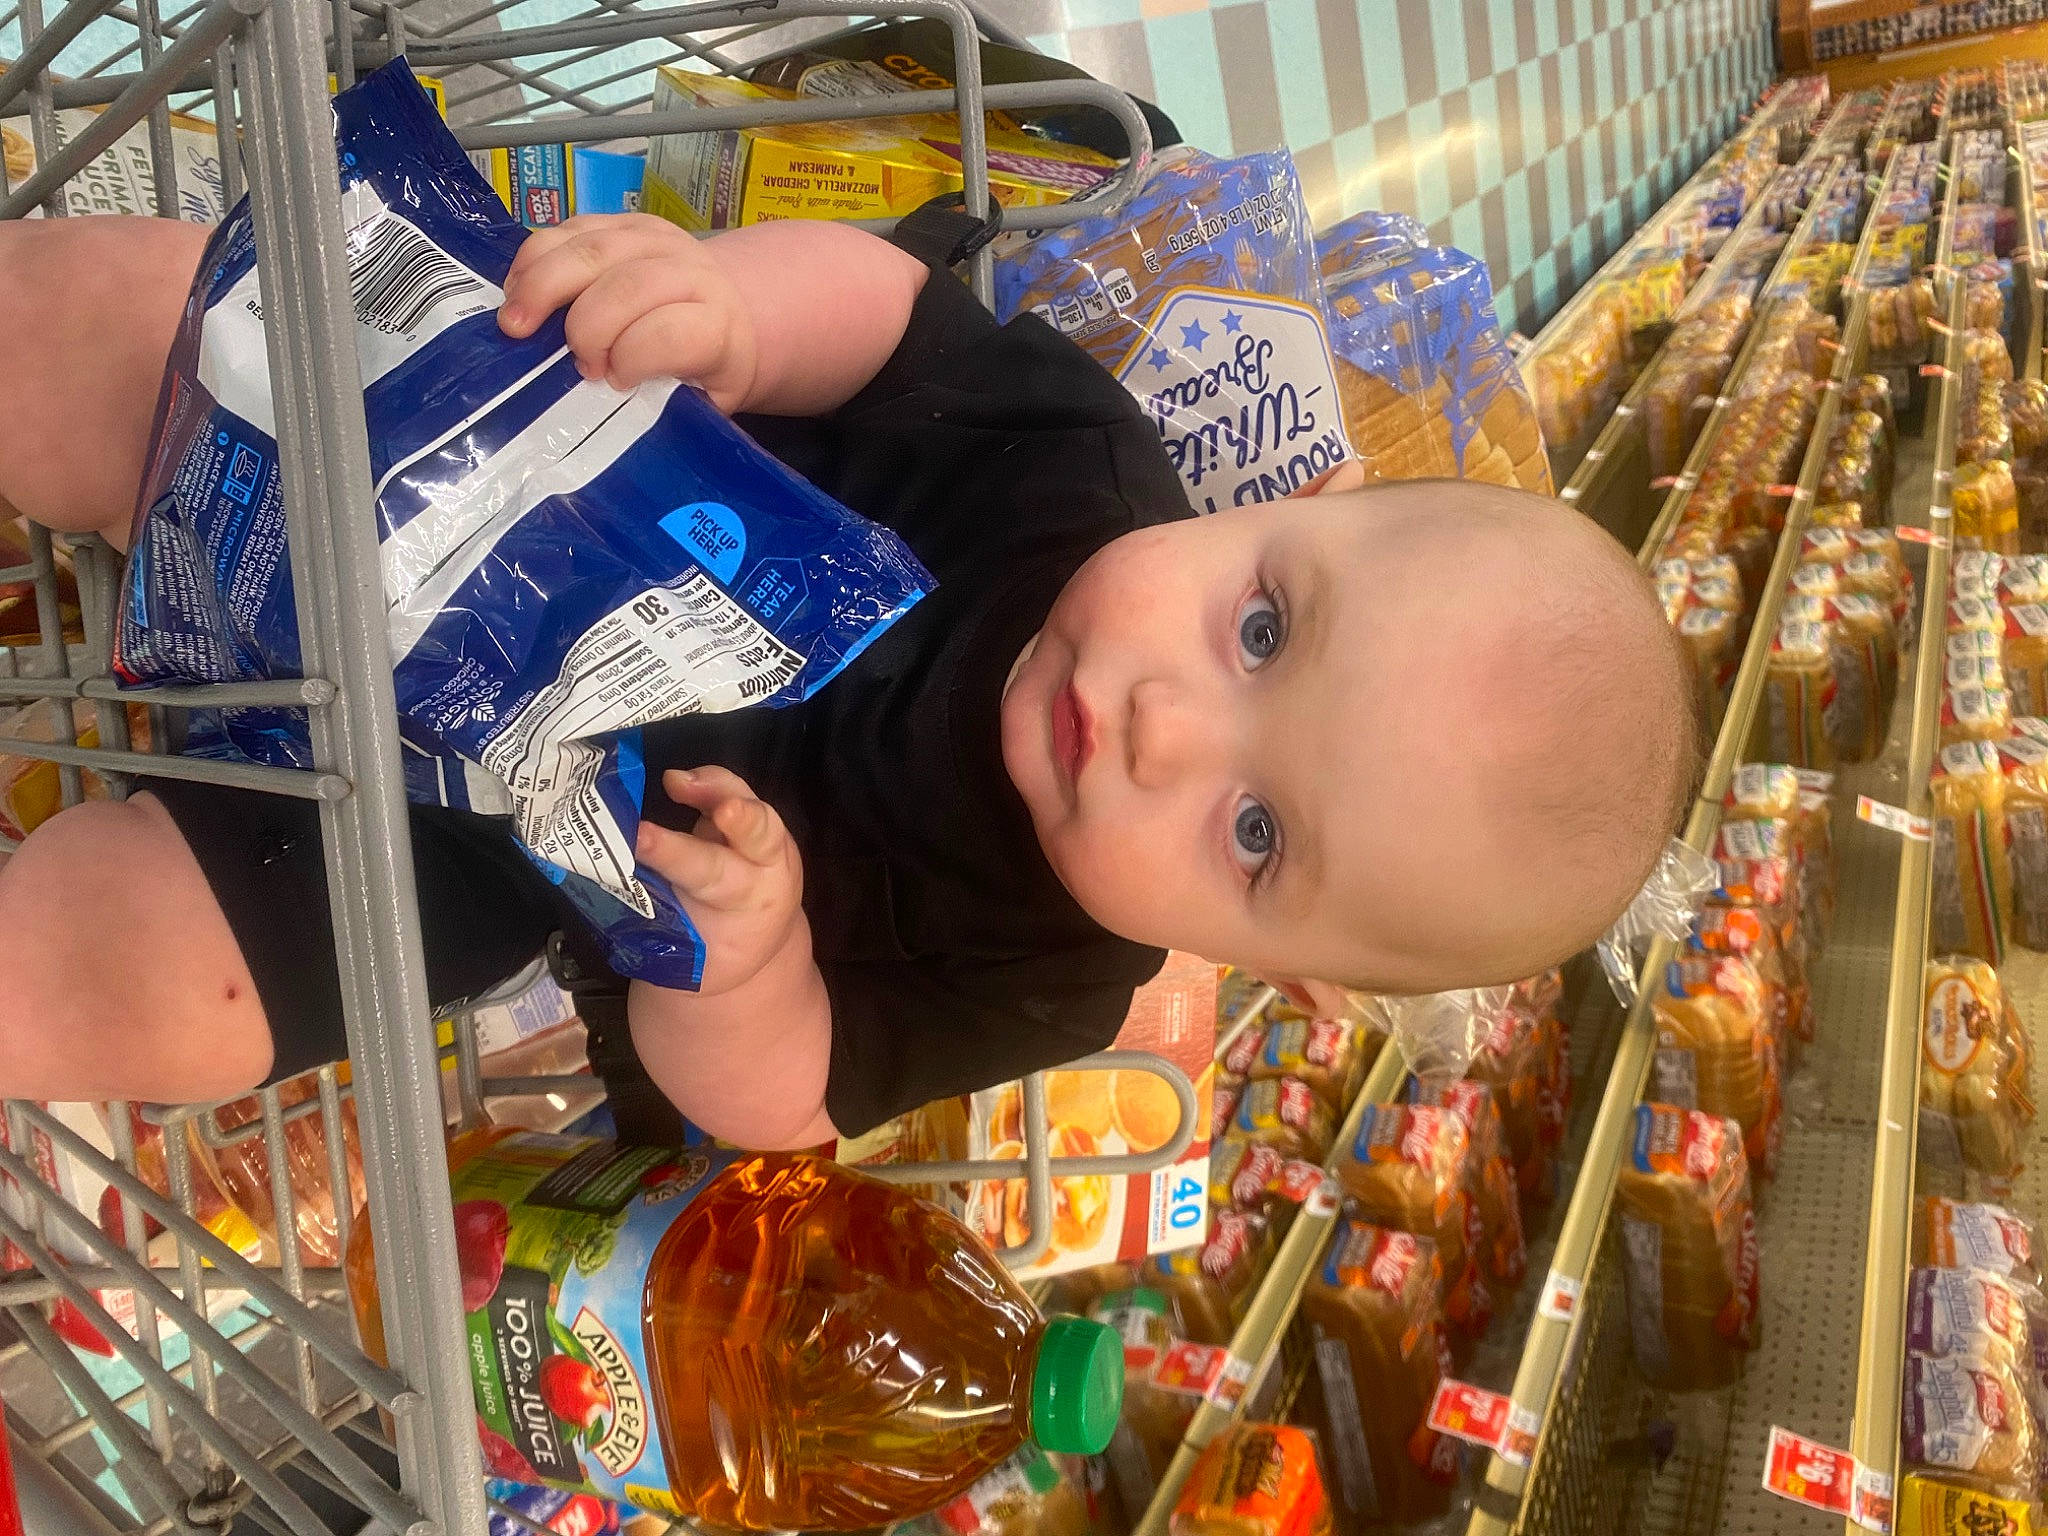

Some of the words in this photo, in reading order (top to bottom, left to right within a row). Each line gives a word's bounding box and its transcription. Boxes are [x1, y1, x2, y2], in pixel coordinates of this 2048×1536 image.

[884, 55, 954, 89] cro
[510, 162, 519, 174] THE
[789, 161, 843, 175] PARMESAN
[849, 166, 855, 177] &
[84, 165, 112, 210] UCE
[102, 149, 133, 214] PRIMA
[760, 174, 810, 190] CHEDDAR,
[816, 178, 879, 195] MOZZARELLA,
[180, 190, 210, 224] Me
[530, 194, 546, 224] BOX
[541, 189, 553, 220] TOPS
[778, 193, 803, 207] Real
[806, 197, 829, 208] with
[831, 199, 863, 211] Made
[1256, 193, 1272, 208] OZ
[1220, 215, 1228, 230] 4
[1227, 206, 1244, 225] LB
[1253, 216, 1273, 234] WT
[1168, 228, 1200, 252] 567g
[1114, 284, 1132, 304] 80
[246, 301, 264, 321] BES
[1150, 334, 1273, 437] Bread
[204, 422, 214, 445] SIDE
[1162, 383, 1316, 486] White
[211, 451, 225, 482] PLACE
[269, 462, 279, 480] ANY
[1233, 428, 1345, 508] ROUND
[253, 481, 274, 532] LEFTOVERS.
[262, 510, 275, 535] COOK
[691, 508, 720, 538] PICK
[718, 532, 739, 551] UP
[240, 533, 257, 568] REHEAT
[251, 535, 264, 559] ONLY
[688, 525, 723, 560] HERE
[247, 560, 257, 577] ONE
[260, 552, 270, 569] NOT
[230, 569, 245, 602] BEFORE
[693, 578, 707, 590] per
[747, 569, 782, 608] HERE
[632, 595, 670, 625] 30
[727, 605, 737, 614] 1
[759, 582, 796, 618] TEAR
[714, 610, 731, 625] 1/3
[173, 633, 185, 651] Hold
[196, 635, 206, 653] tabs
[605, 628, 636, 649] Vitamin
[596, 646, 604, 656] D
[622, 645, 653, 664] Sodium
[735, 635, 784, 668] Facts
[470, 663, 486, 679] P.O.
[571, 653, 596, 672] 0mcg
[596, 663, 624, 683] 20mg
[440, 657, 476, 692] CHICAGO,
[620, 658, 667, 690] Cholesterol
[650, 674, 675, 693] Trans
[737, 651, 802, 699] Nutrition
[451, 679, 471, 695] BOX
[597, 687, 621, 703] 0mg
[638, 689, 653, 702] Fat
[433, 680, 503, 732] CONAGRA
[624, 697, 640, 709] 0g
[647, 687, 688, 719] Saturated
[487, 689, 535, 739] DISTRIBUTED
[521, 705, 551, 738] Calcium
[519, 775, 531, 790] 1%
[538, 778, 550, 792] 0%
[545, 839, 558, 854] 2g
[562, 831, 575, 847] 2g
[1169, 1176, 1202, 1229] 40
[472, 1334, 488, 1378] apple
[498, 1336, 512, 1386] SERVINGS
[505, 1297, 532, 1384] 100%
[519, 1387, 556, 1465] JUICE
[577, 1331, 638, 1411] APPLE
[479, 1378, 496, 1415] juice
[621, 1412, 639, 1429] &
[601, 1427, 640, 1468] EVE
